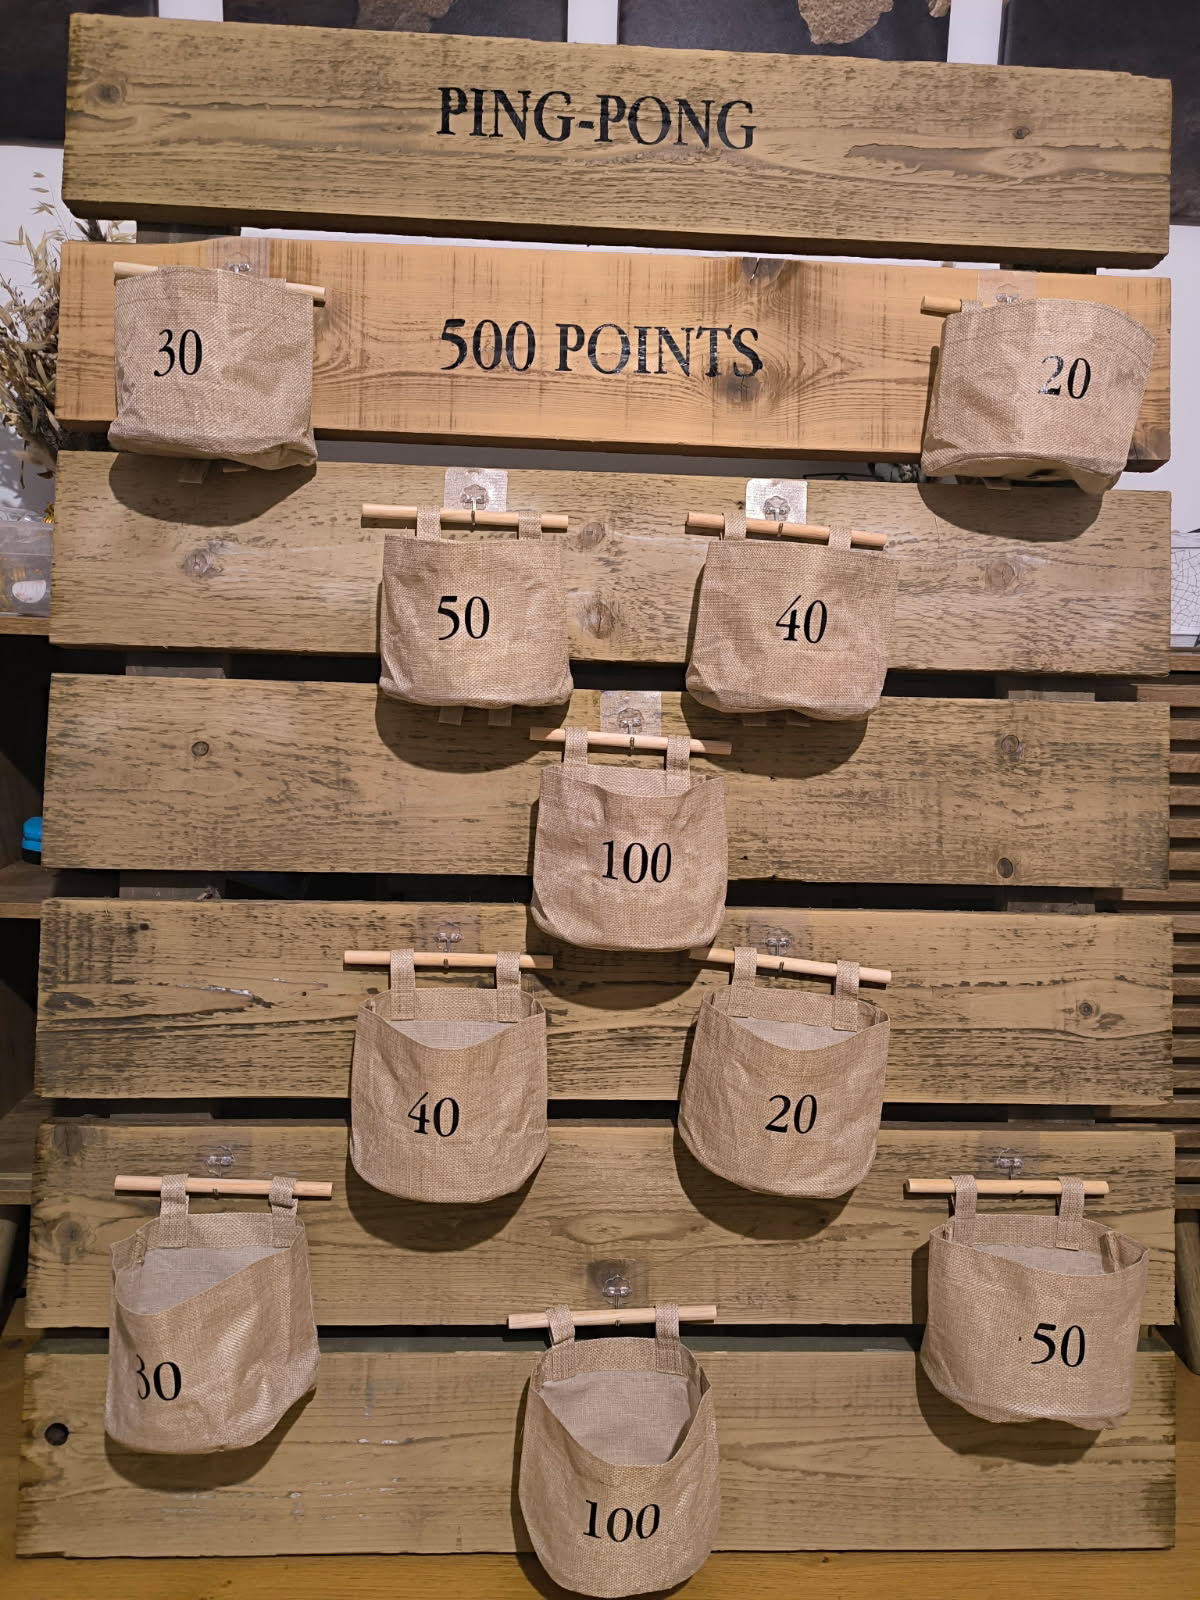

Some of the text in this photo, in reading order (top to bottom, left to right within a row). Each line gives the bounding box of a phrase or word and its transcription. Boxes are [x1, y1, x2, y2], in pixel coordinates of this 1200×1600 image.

[436, 86, 757, 150] PING-PONG
[153, 328, 203, 378] 30
[441, 318, 764, 378] 500 POINTS
[1038, 355, 1091, 400] 20
[437, 595, 490, 641] 50
[775, 594, 828, 644] 40
[602, 840, 672, 884] 100
[407, 1091, 460, 1138] 40
[764, 1094, 818, 1135] 20
[1030, 1322, 1086, 1368] 50
[583, 1499, 661, 1543] 100
